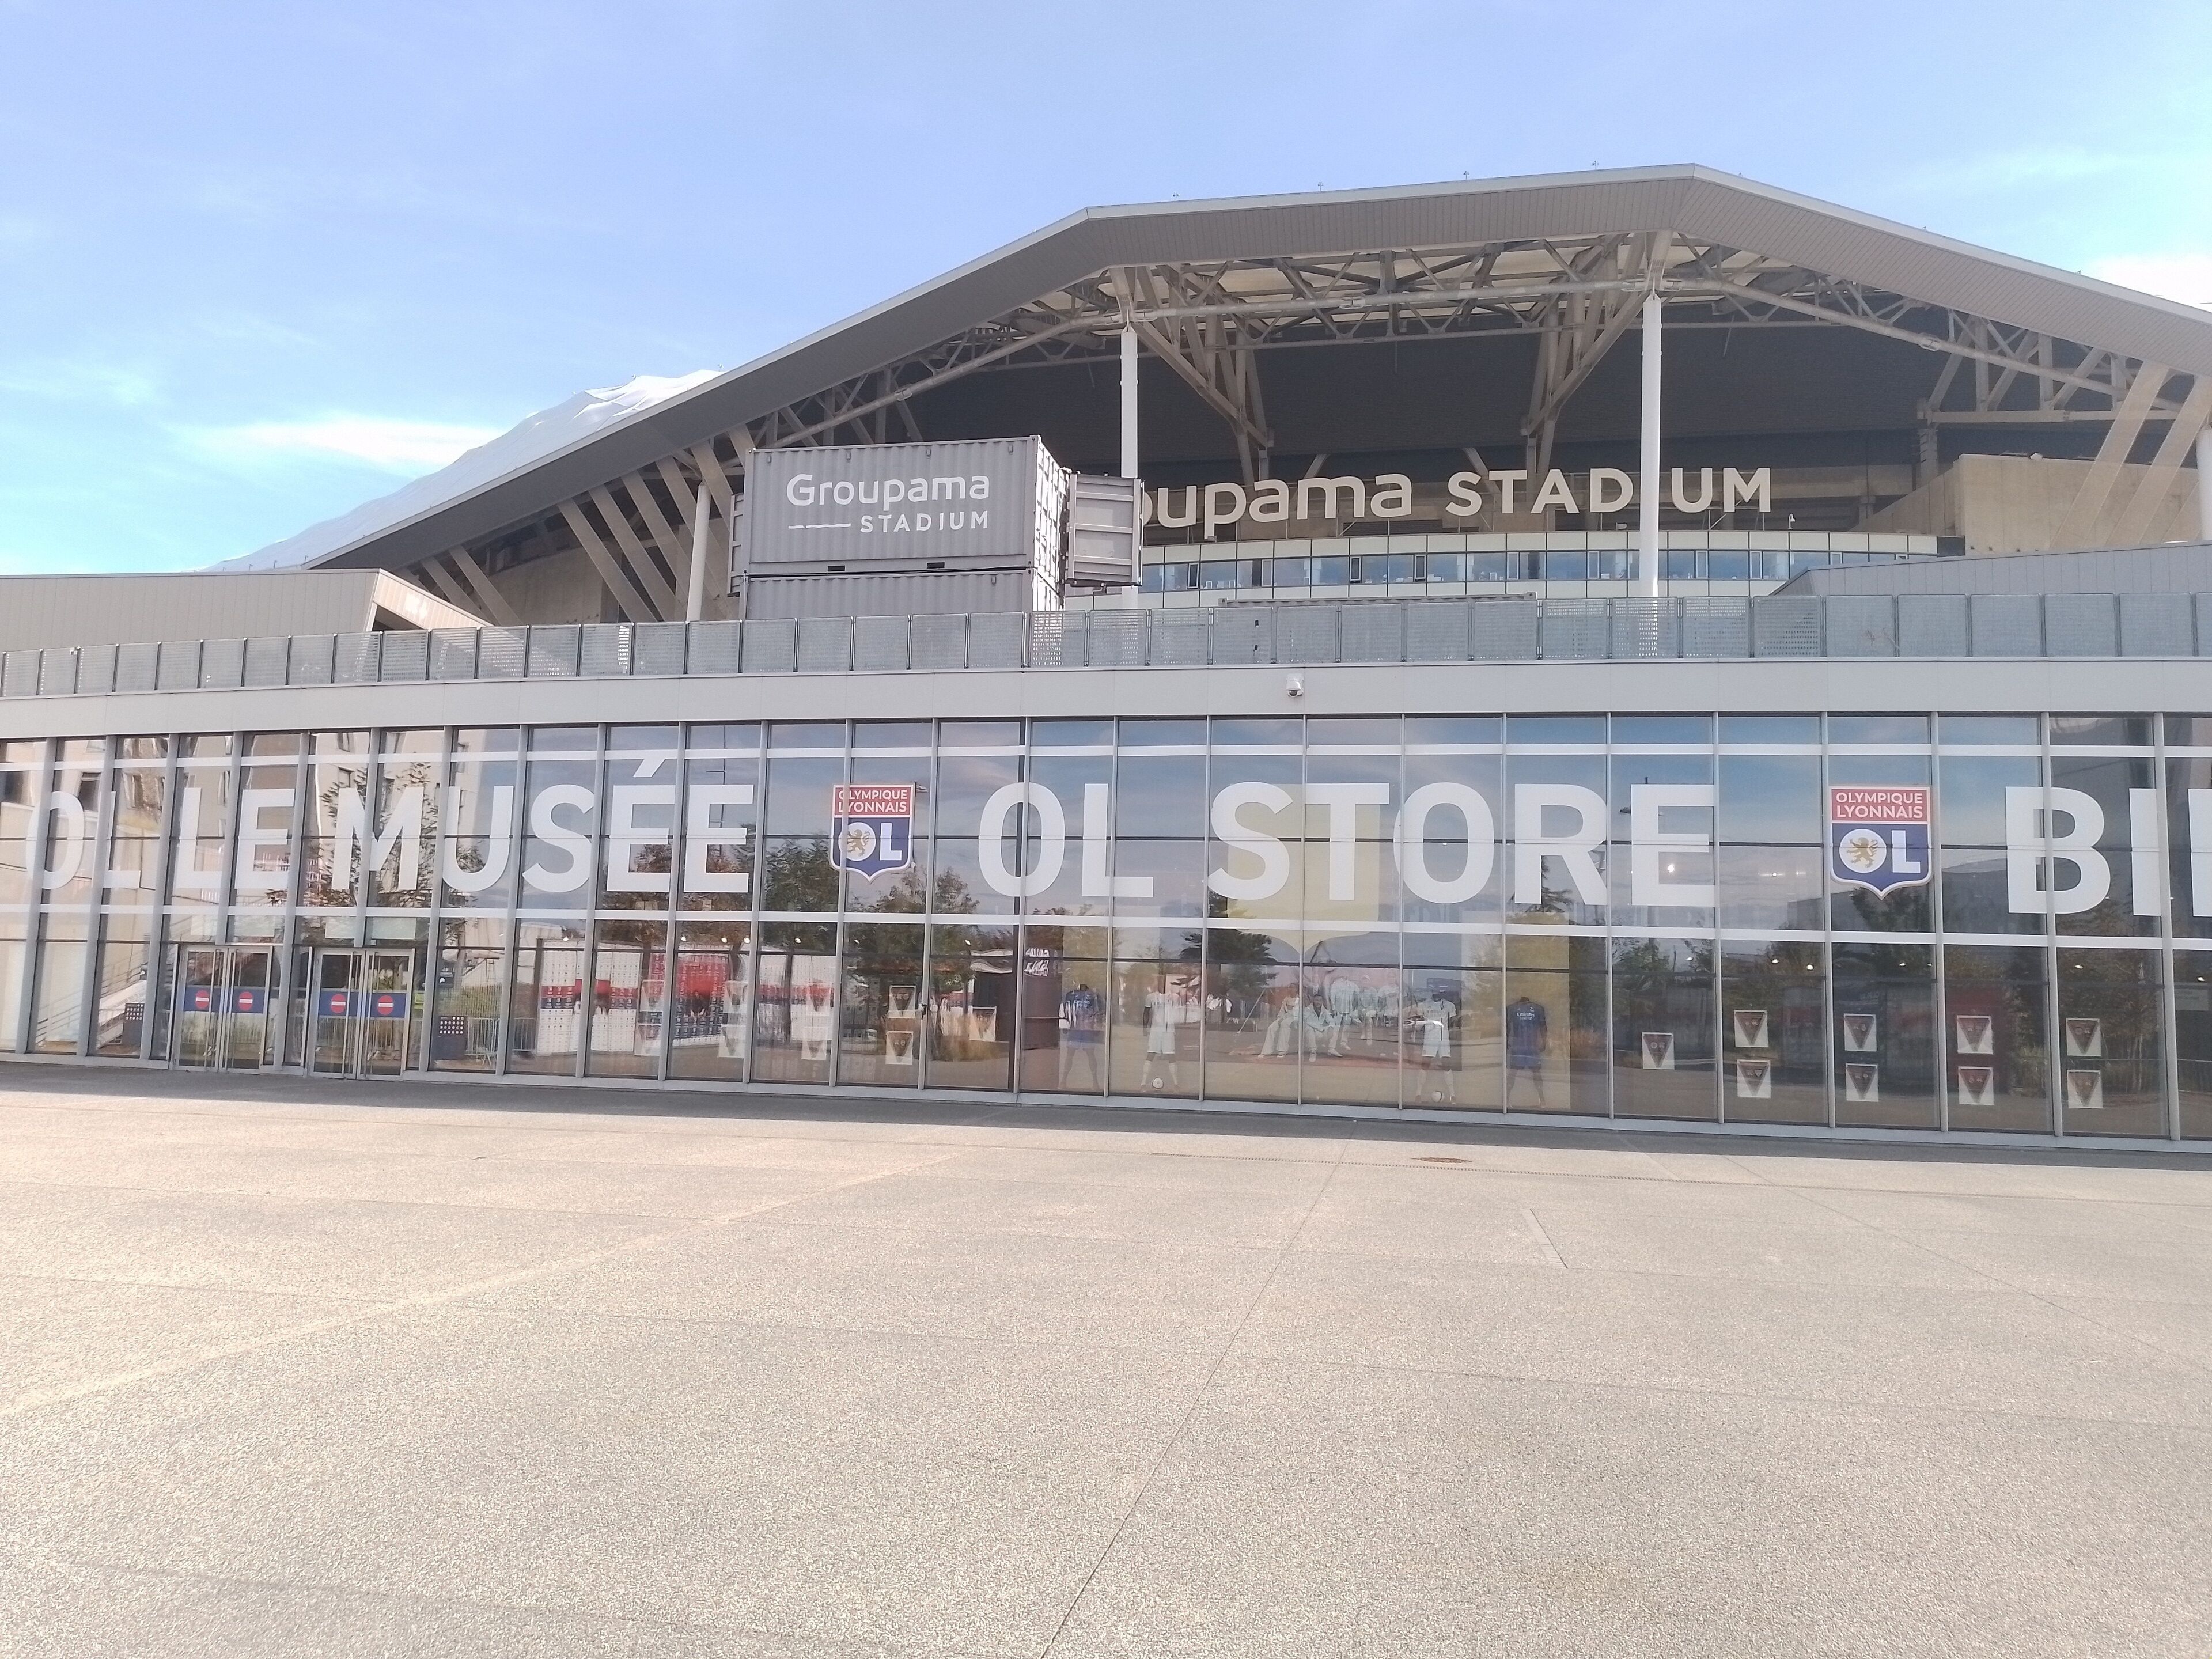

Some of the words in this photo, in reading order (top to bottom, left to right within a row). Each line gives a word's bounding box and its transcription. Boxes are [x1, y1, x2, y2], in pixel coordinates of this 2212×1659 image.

[786, 474, 990, 508] Groupama
[1143, 472, 1413, 540] upama
[1445, 467, 1771, 516] STADUM
[860, 510, 990, 533] STADIUM
[1836, 793, 1923, 805] OLYMPIQUE
[1836, 805, 1923, 819] LYONNAIS
[174, 787, 295, 891] LE
[331, 758, 754, 893] MUSÉE
[978, 782, 1154, 897] OL
[1207, 781, 1717, 907] STORE
